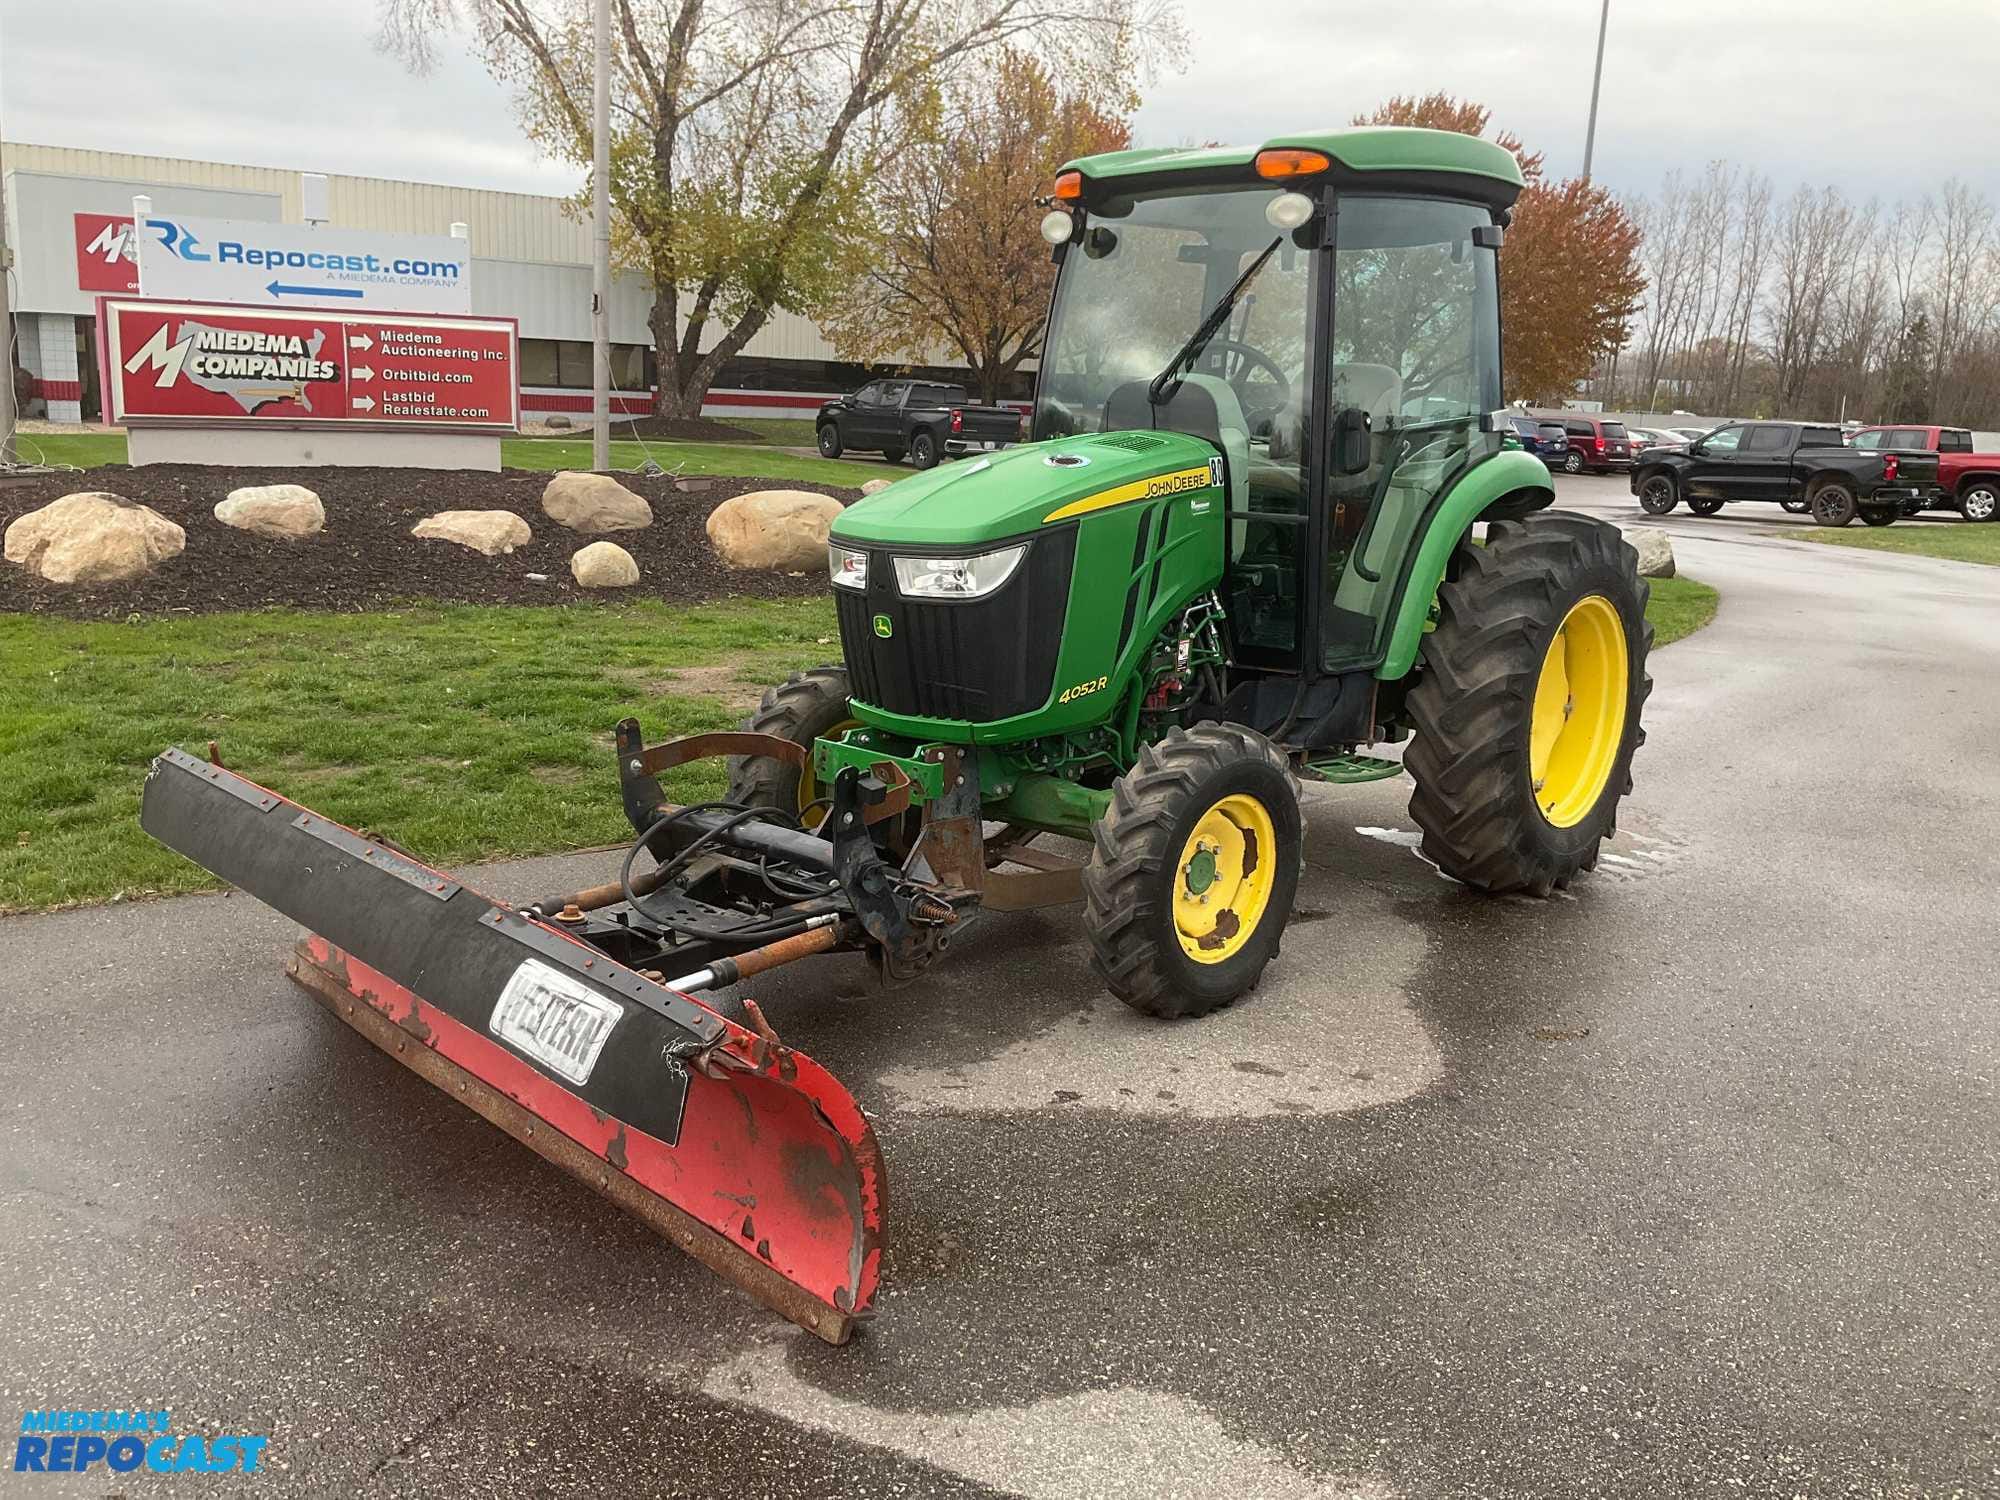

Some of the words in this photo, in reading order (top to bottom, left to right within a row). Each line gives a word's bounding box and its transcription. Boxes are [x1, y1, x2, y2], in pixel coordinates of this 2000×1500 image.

[218, 241, 459, 278] Repocast.com
[326, 272, 336, 280] A
[339, 272, 396, 285] MIEDEMA
[400, 276, 458, 288] COMPANY
[196, 331, 304, 355] MIEDEMA
[380, 330, 442, 344] Miedema
[381, 344, 479, 361] Auctioneering
[483, 348, 508, 360] Inc.
[190, 355, 335, 379] COMPANIES
[382, 369, 473, 383] Orbitbid.com
[383, 390, 435, 403] Lastbid
[383, 403, 489, 417] Realestate.com
[1210, 458, 1224, 486] 80
[1145, 480, 1173, 499] JOHN
[1173, 474, 1205, 491] DEERE
[1059, 676, 1108, 704] 4052R
